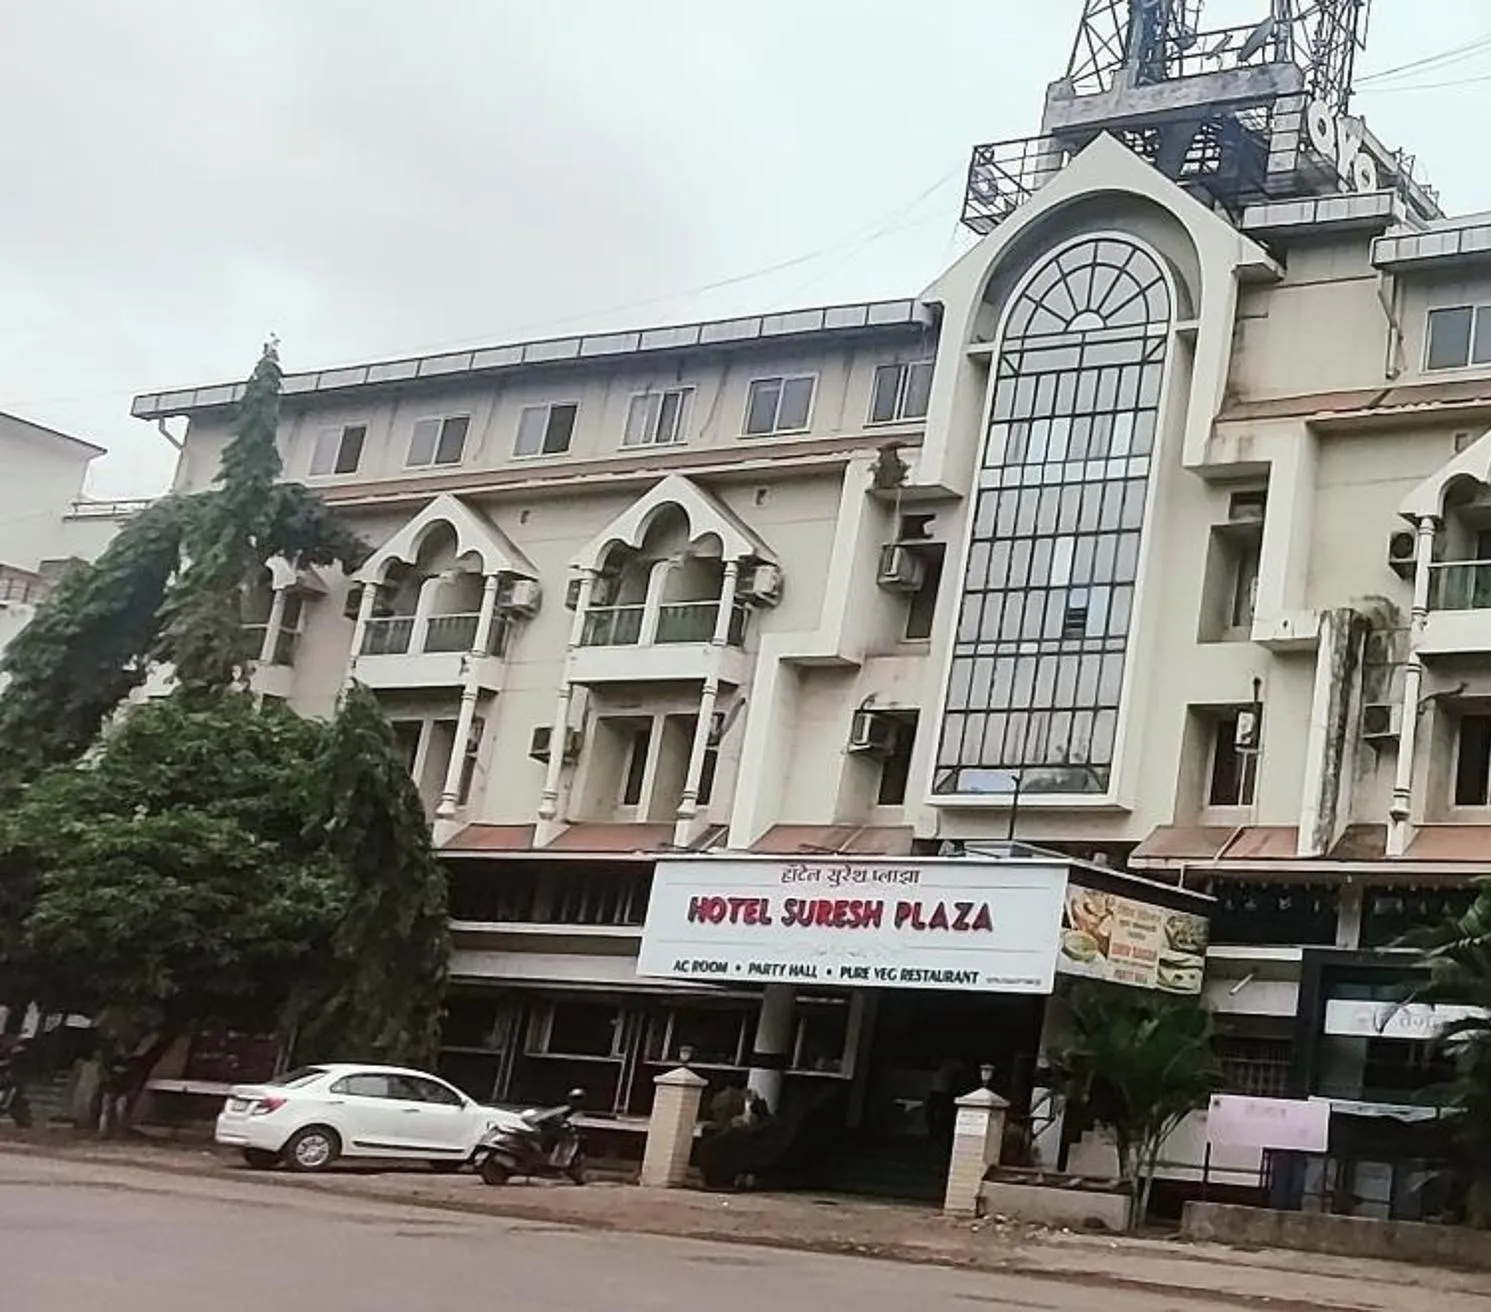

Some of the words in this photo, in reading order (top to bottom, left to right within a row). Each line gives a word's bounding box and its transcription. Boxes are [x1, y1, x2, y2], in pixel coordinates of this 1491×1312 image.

[827, 865, 867, 886] सुरेश
[872, 869, 920, 885] प्लाझा
[687, 896, 772, 926] HOTEL
[781, 898, 883, 929] SURESH
[895, 901, 993, 932] PLAZA
[673, 960, 690, 973] AC
[691, 961, 729, 974] ROOM
[747, 962, 787, 977] PARTY
[789, 964, 818, 978] HALL
[840, 966, 870, 980] PURE
[874, 968, 898, 981] VEG
[900, 968, 980, 985] RESTAURANT
